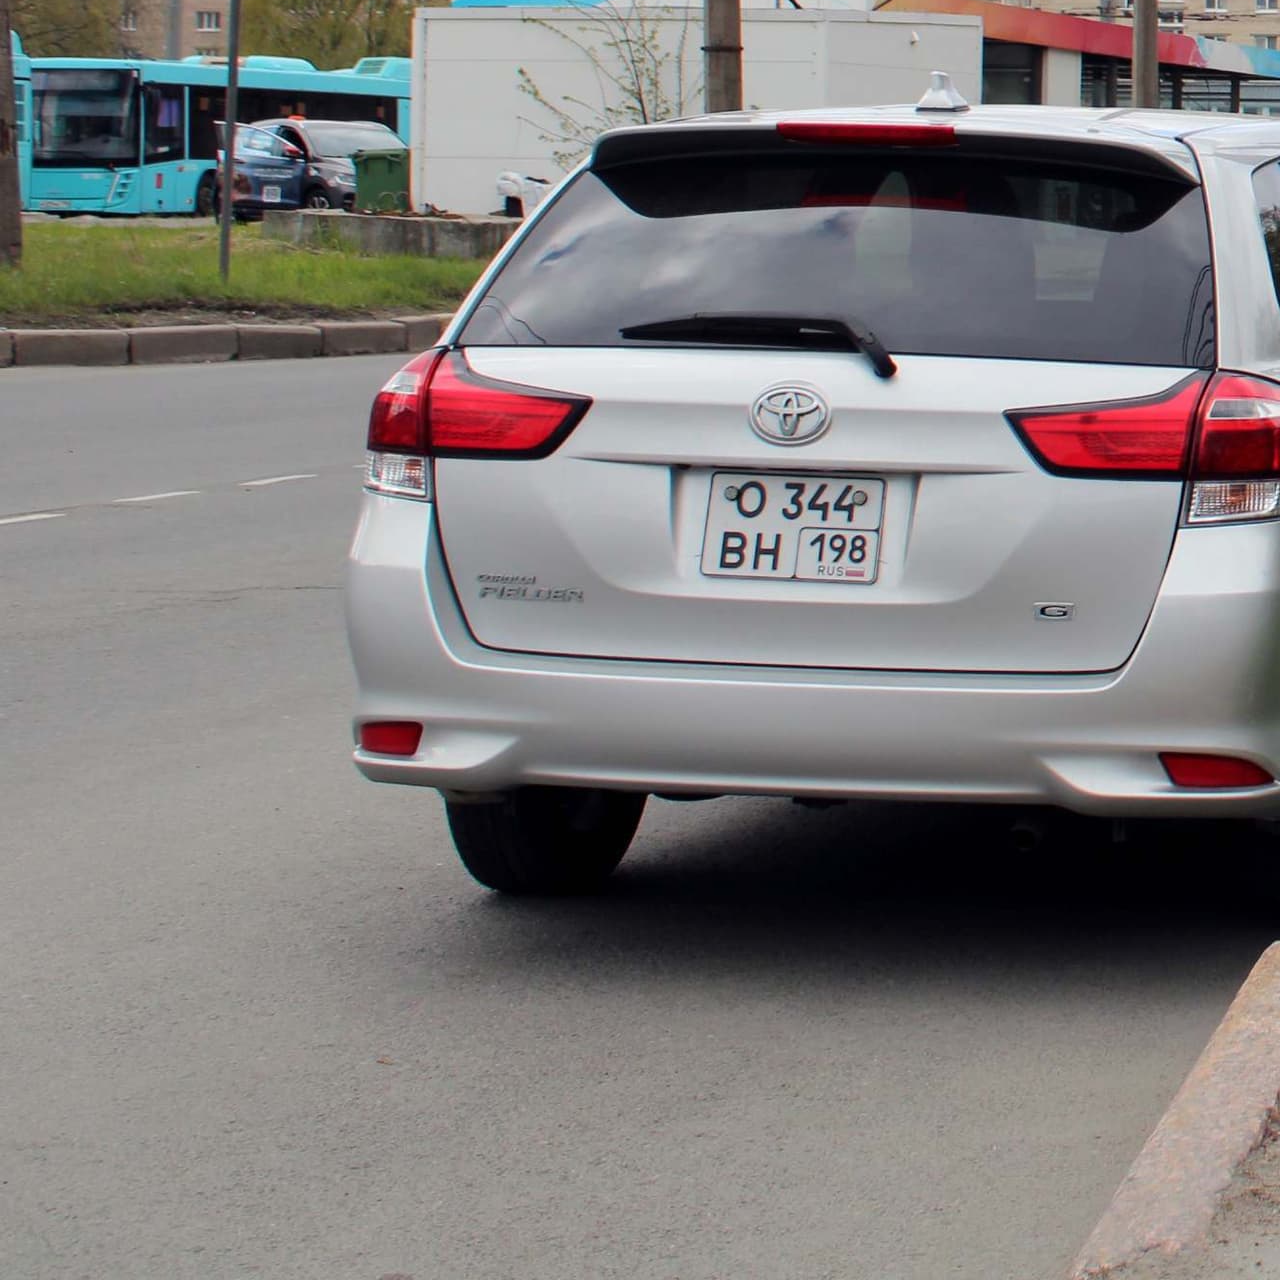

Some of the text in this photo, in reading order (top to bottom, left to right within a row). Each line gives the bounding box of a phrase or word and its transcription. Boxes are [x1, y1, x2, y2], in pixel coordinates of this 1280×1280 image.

[782, 482, 854, 523] 344
[719, 531, 868, 571] ВН 198
[817, 565, 845, 577] RUS
[1040, 605, 1068, 617] G
